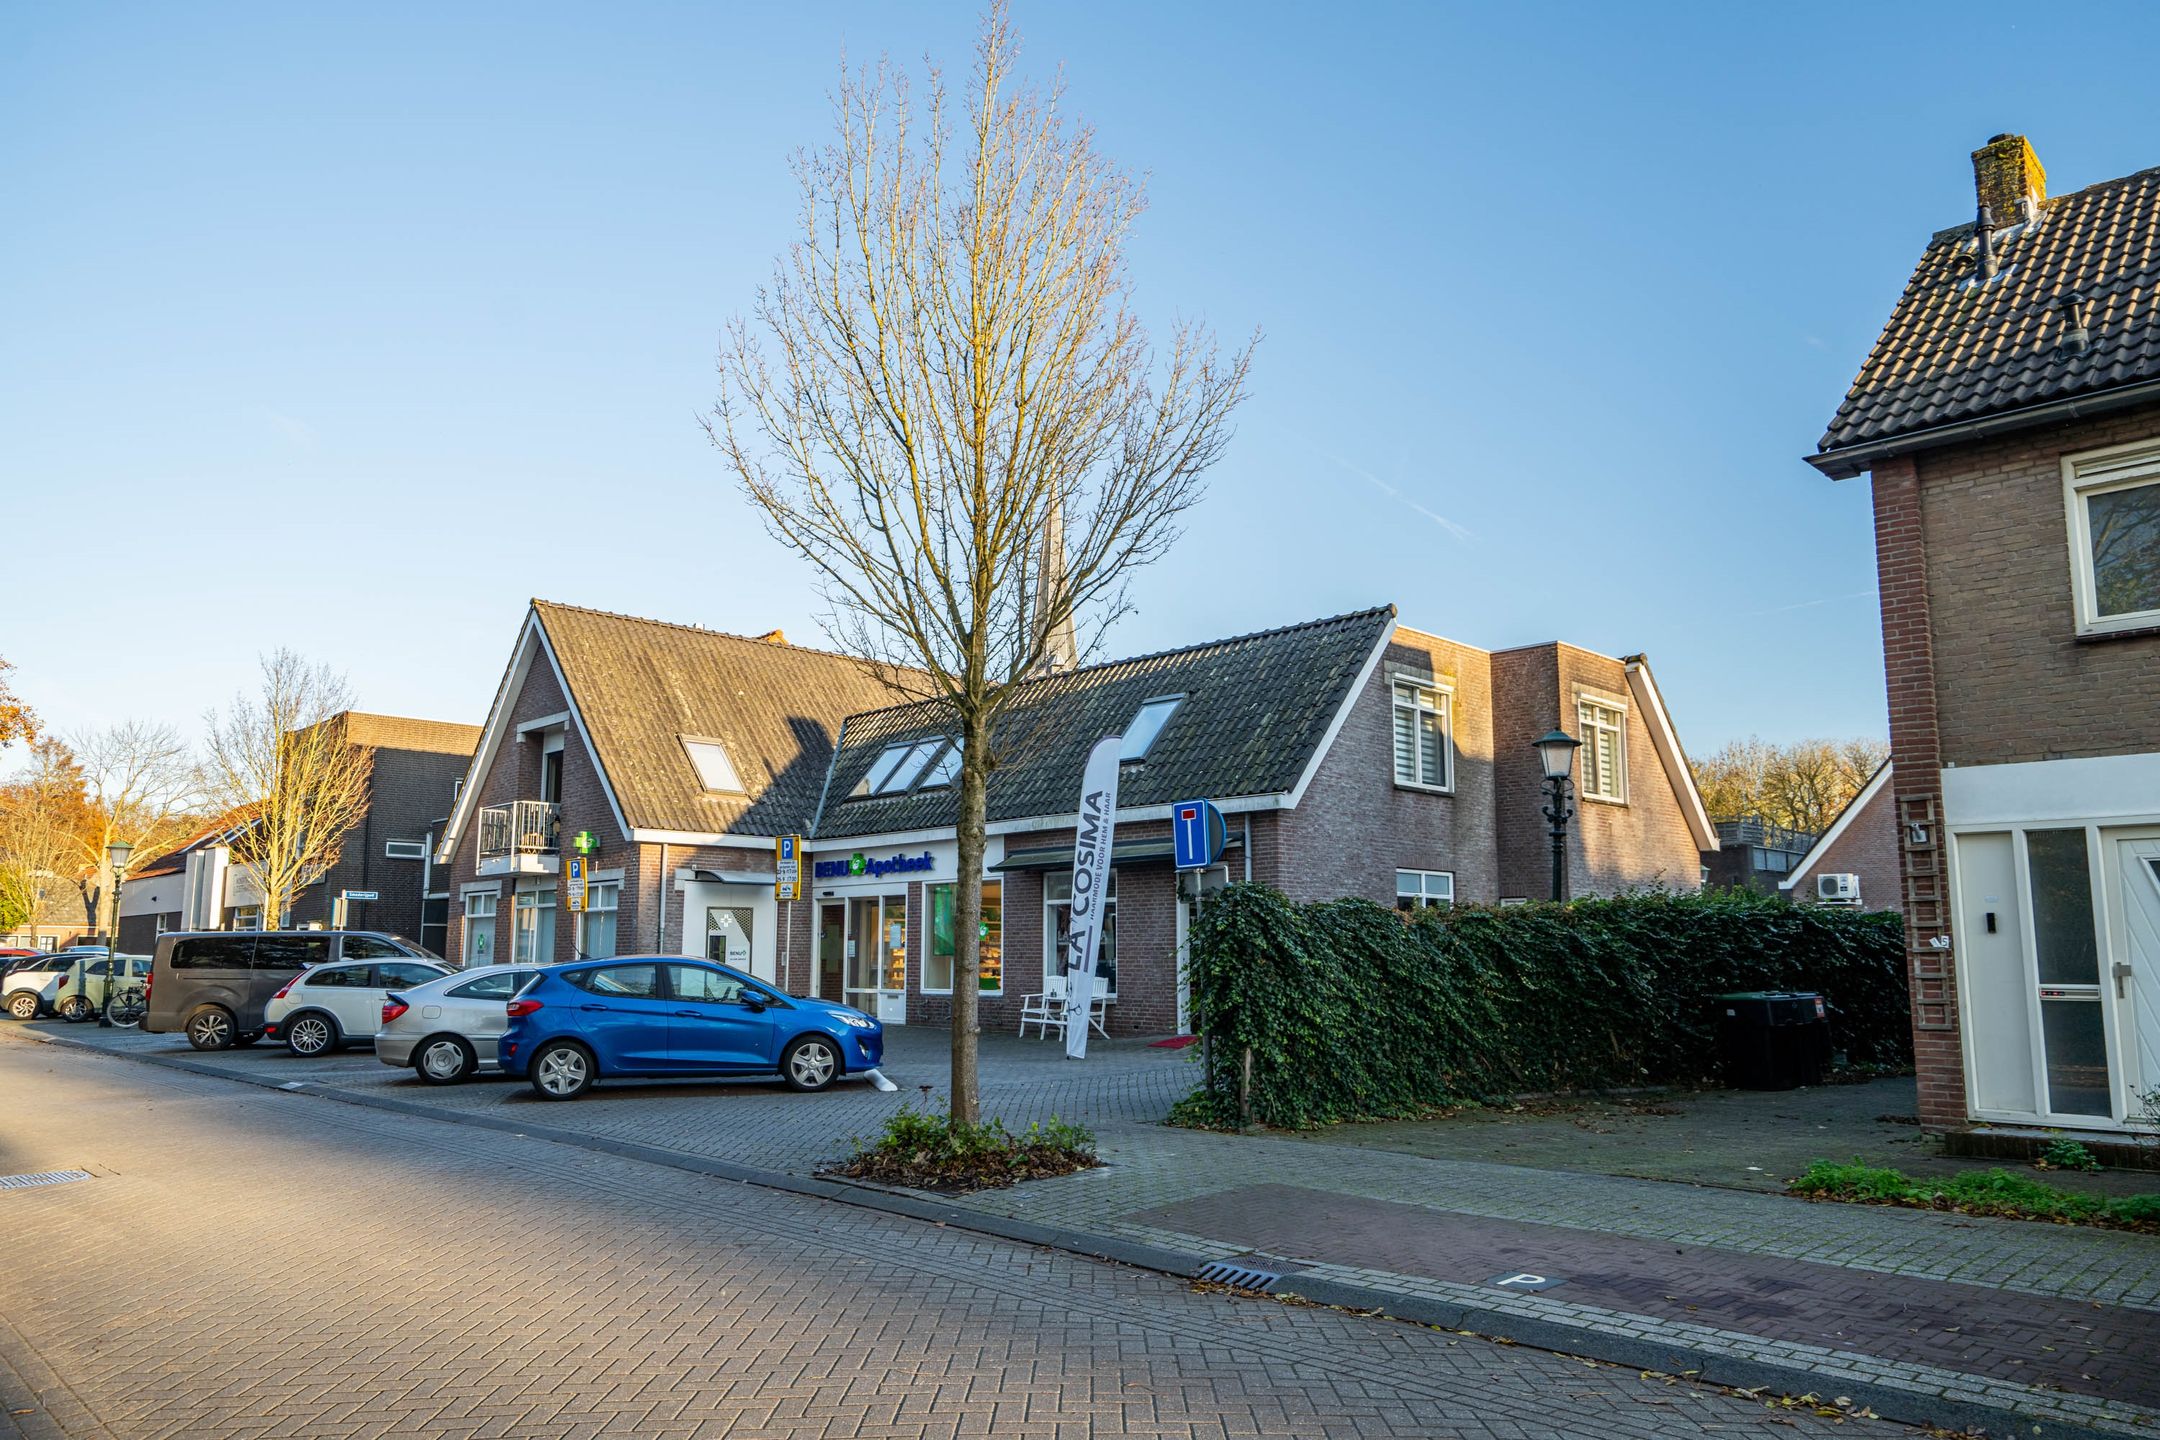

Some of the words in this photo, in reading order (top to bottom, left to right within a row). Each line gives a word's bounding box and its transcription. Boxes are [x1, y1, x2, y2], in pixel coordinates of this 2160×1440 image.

[1103, 792, 1111, 816] HAAR
[1100, 826, 1109, 845] HEM
[783, 840, 791, 858] P
[1096, 846, 1106, 870] VOOR
[572, 862, 579, 877] P
[815, 860, 849, 878] BENU
[865, 851, 933, 878] Apotheek
[1496, 1273, 1546, 1286] P
